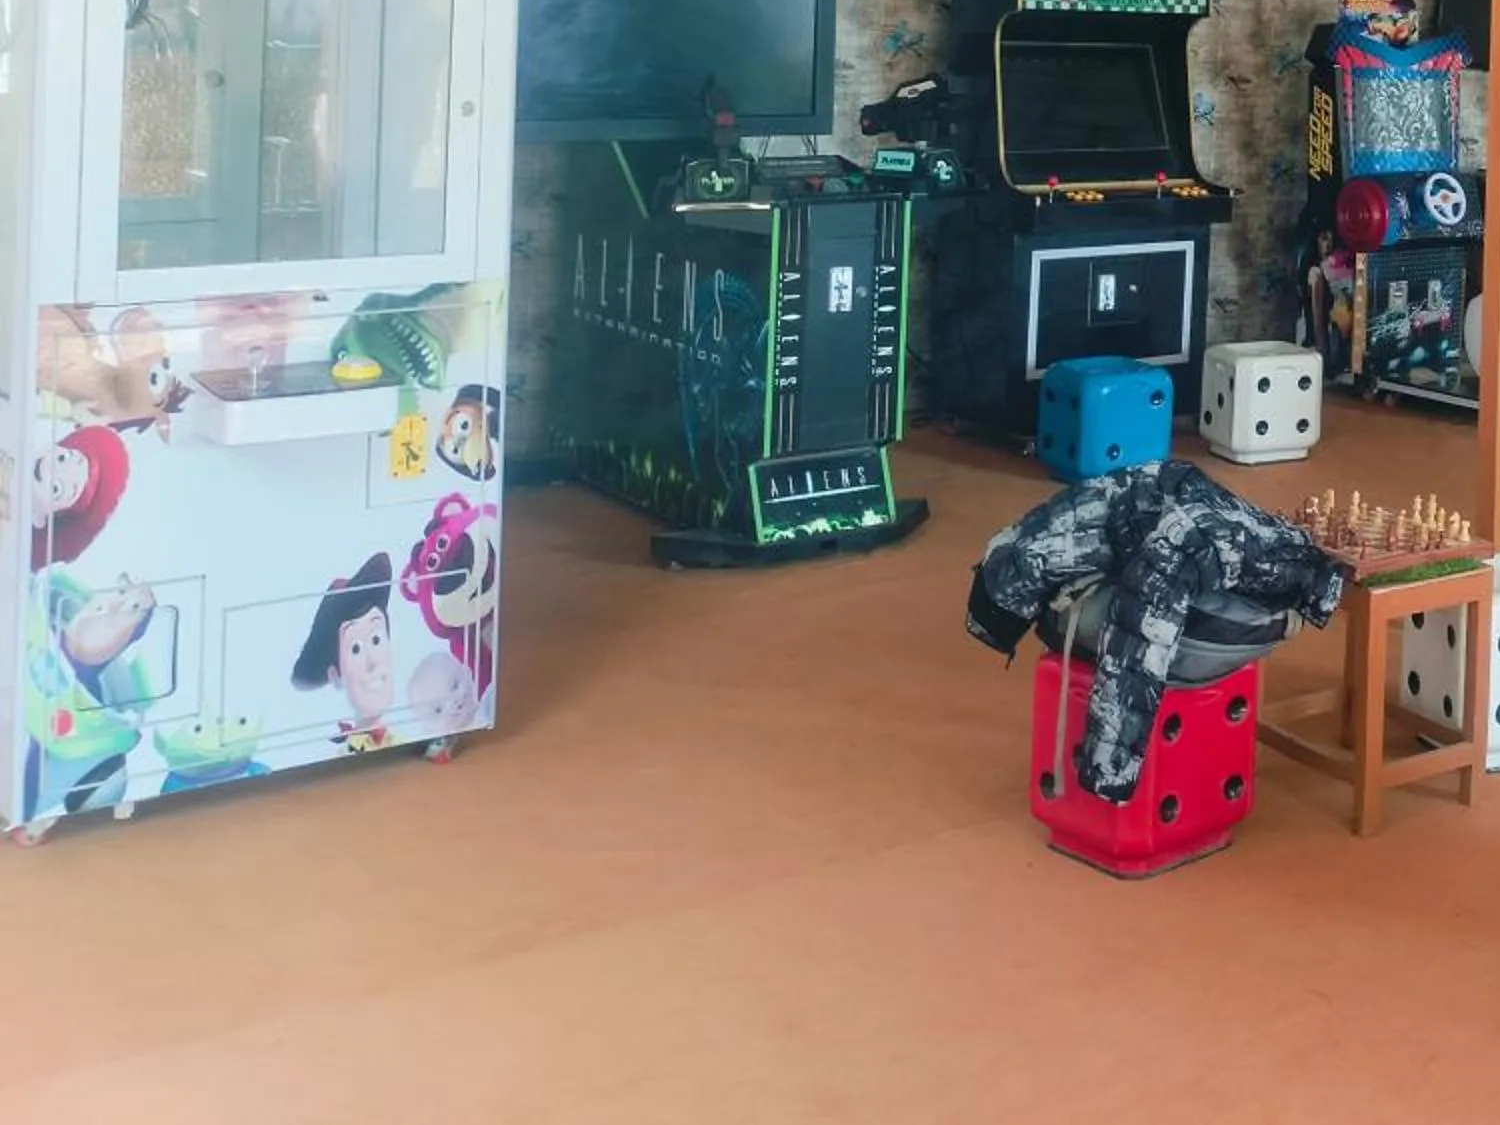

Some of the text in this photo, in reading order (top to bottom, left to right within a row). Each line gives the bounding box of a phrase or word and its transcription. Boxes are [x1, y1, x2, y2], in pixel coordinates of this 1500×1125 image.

[1309, 112, 1322, 181] NEED
[1321, 92, 1333, 176] SPEED
[573, 232, 725, 342] ALIENS
[780, 272, 801, 387] ALIENS
[876, 265, 897, 376] ALIENS
[770, 466, 867, 498] ALIENS
